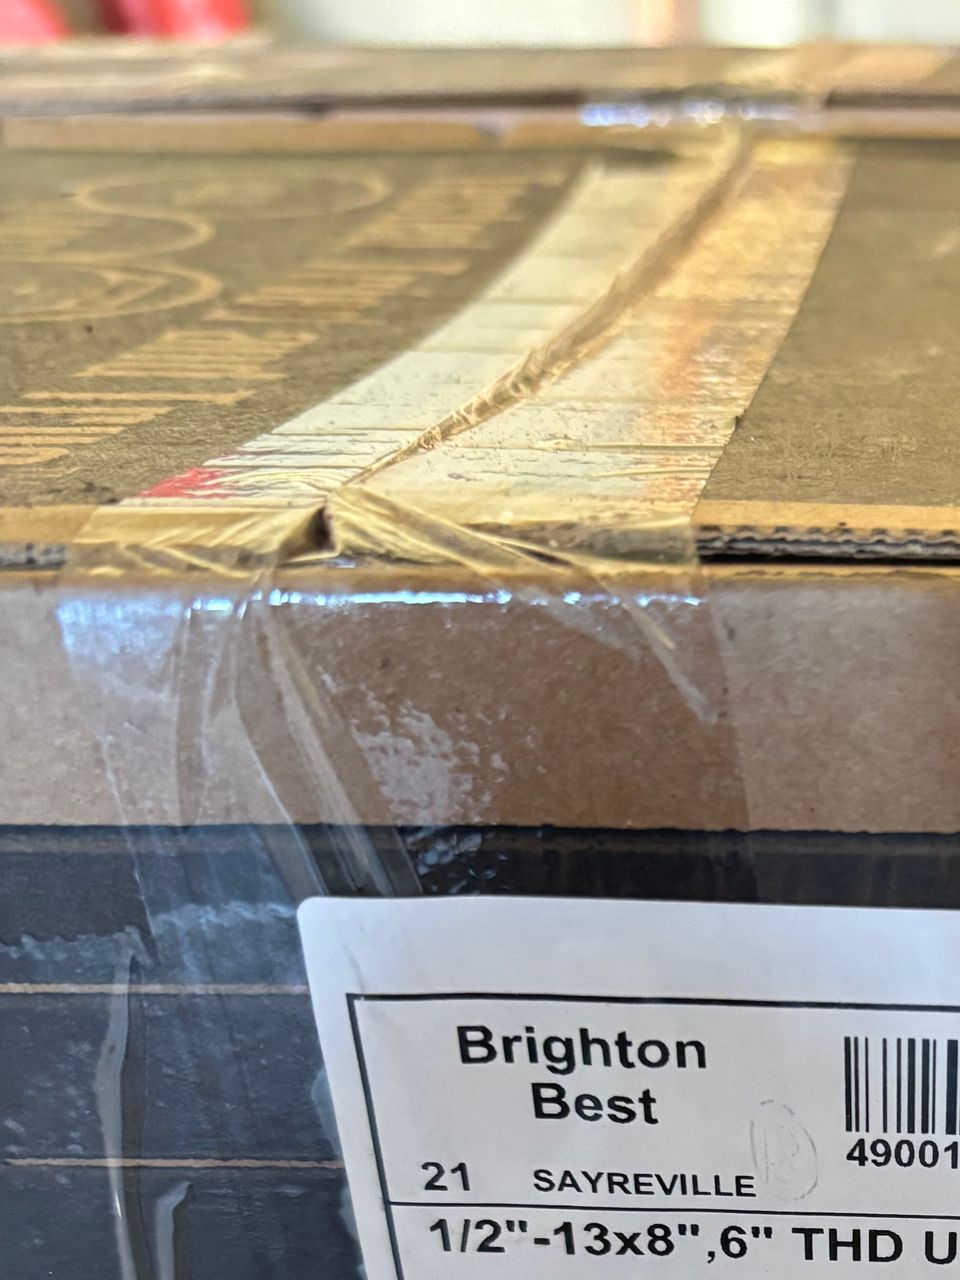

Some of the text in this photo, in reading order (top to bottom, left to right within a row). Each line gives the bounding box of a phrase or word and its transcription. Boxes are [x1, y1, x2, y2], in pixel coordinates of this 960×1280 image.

[457, 1024, 708, 1075] Brighton
[531, 1083, 660, 1126] Best
[422, 1162, 757, 1199] 21 SAYREVILLE
[792, 1227, 904, 1264] THD
